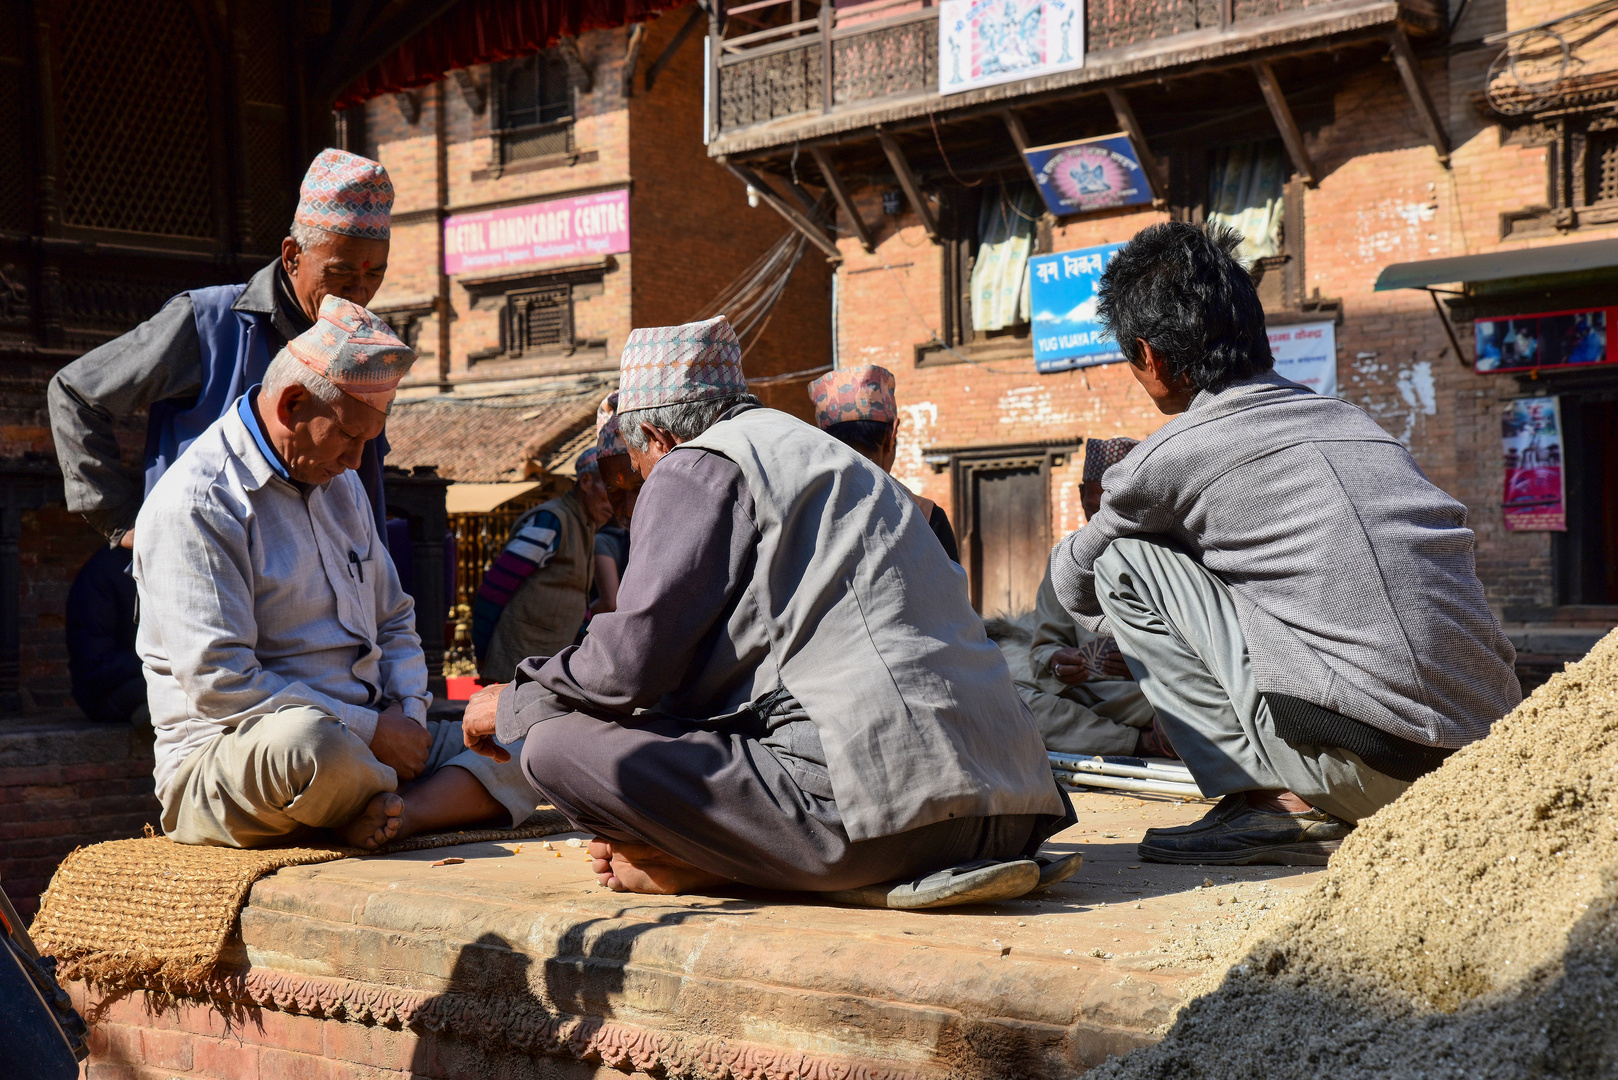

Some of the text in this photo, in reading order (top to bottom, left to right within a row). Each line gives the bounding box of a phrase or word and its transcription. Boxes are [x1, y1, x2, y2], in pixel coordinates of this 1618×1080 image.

[445, 201, 626, 255] METAL HANDICRAFT CENTRE
[1038, 336, 1058, 352] YUG
[1058, 332, 1090, 349] VIJAYA
